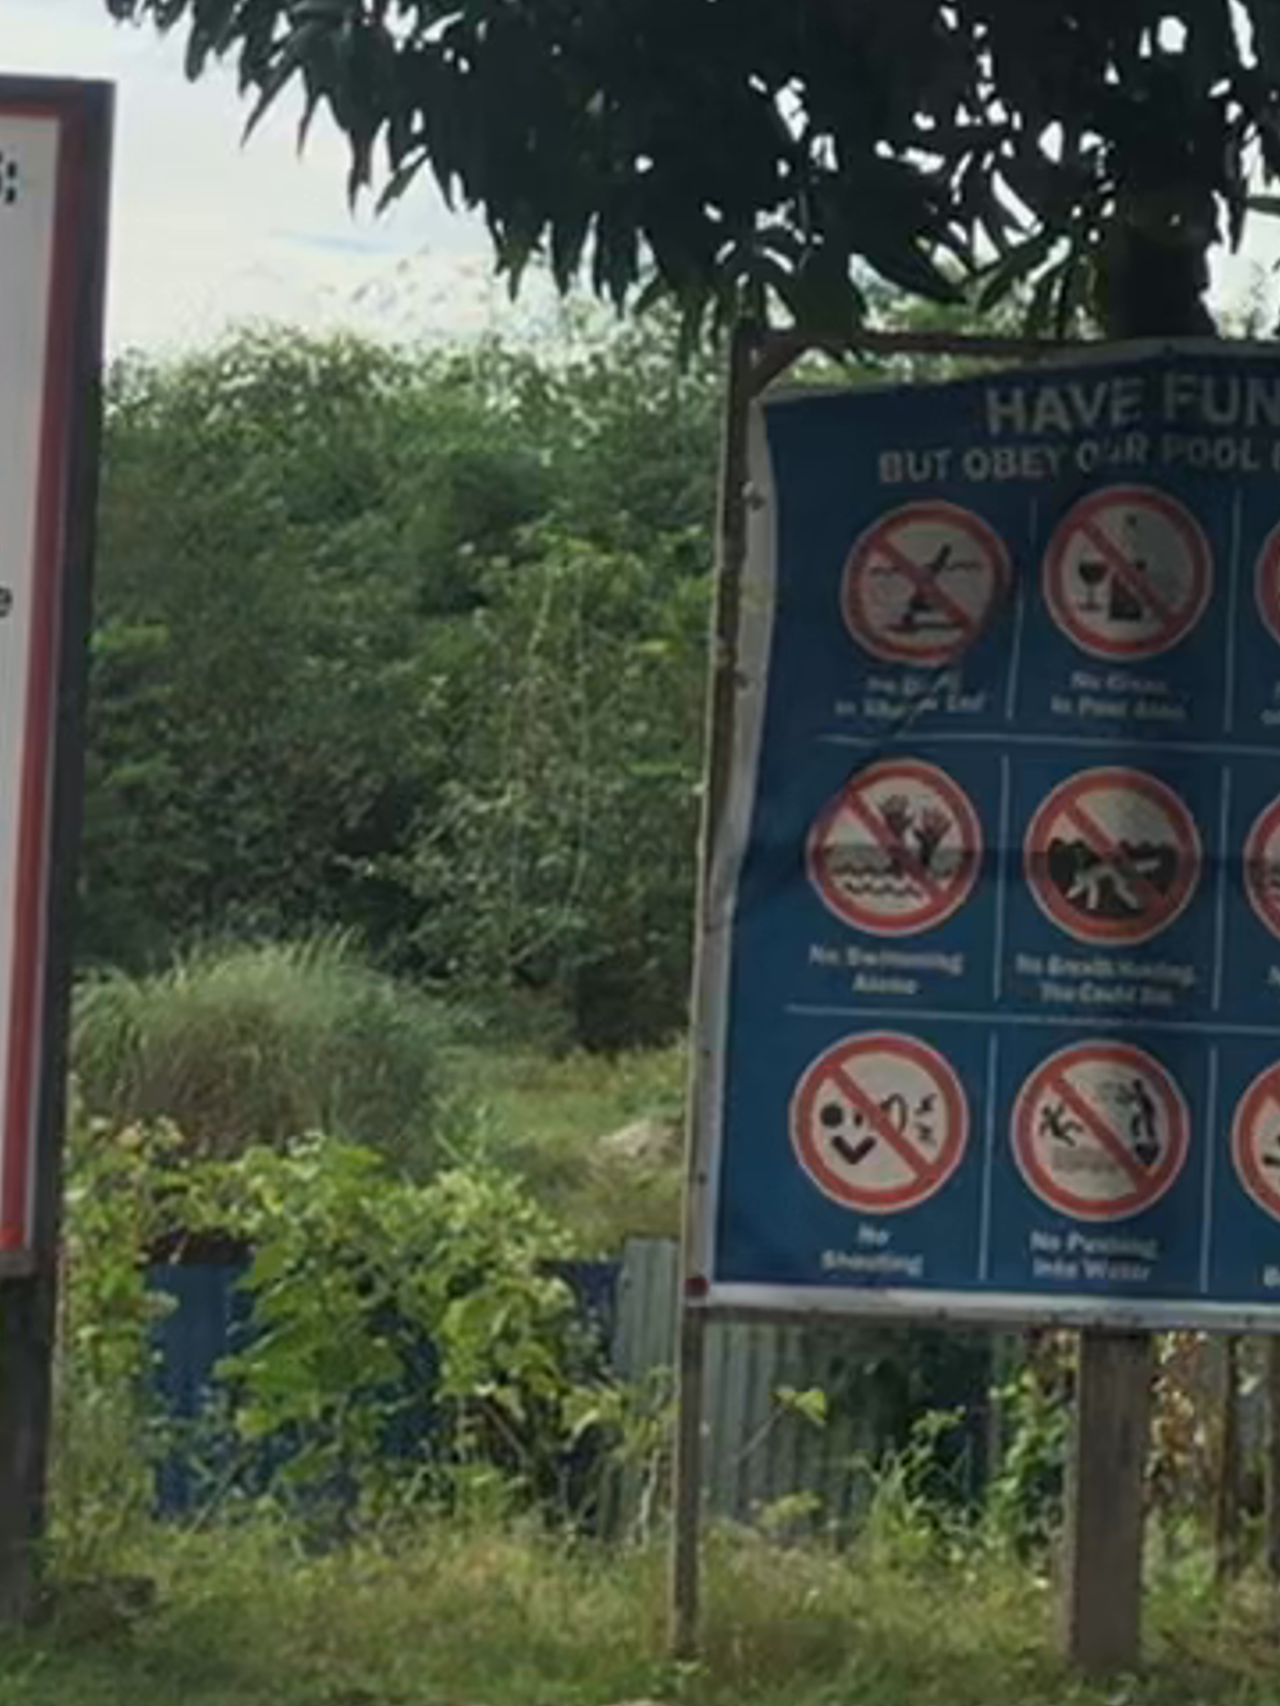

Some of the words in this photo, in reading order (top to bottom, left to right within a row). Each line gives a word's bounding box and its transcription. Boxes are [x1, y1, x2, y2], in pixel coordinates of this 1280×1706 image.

[985, 379, 1144, 435] HAVE
[878, 448, 953, 484] BUT
[963, 444, 1063, 481] OBEY
[1162, 434, 1260, 470] POOL
[857, 1220, 890, 1246] No
